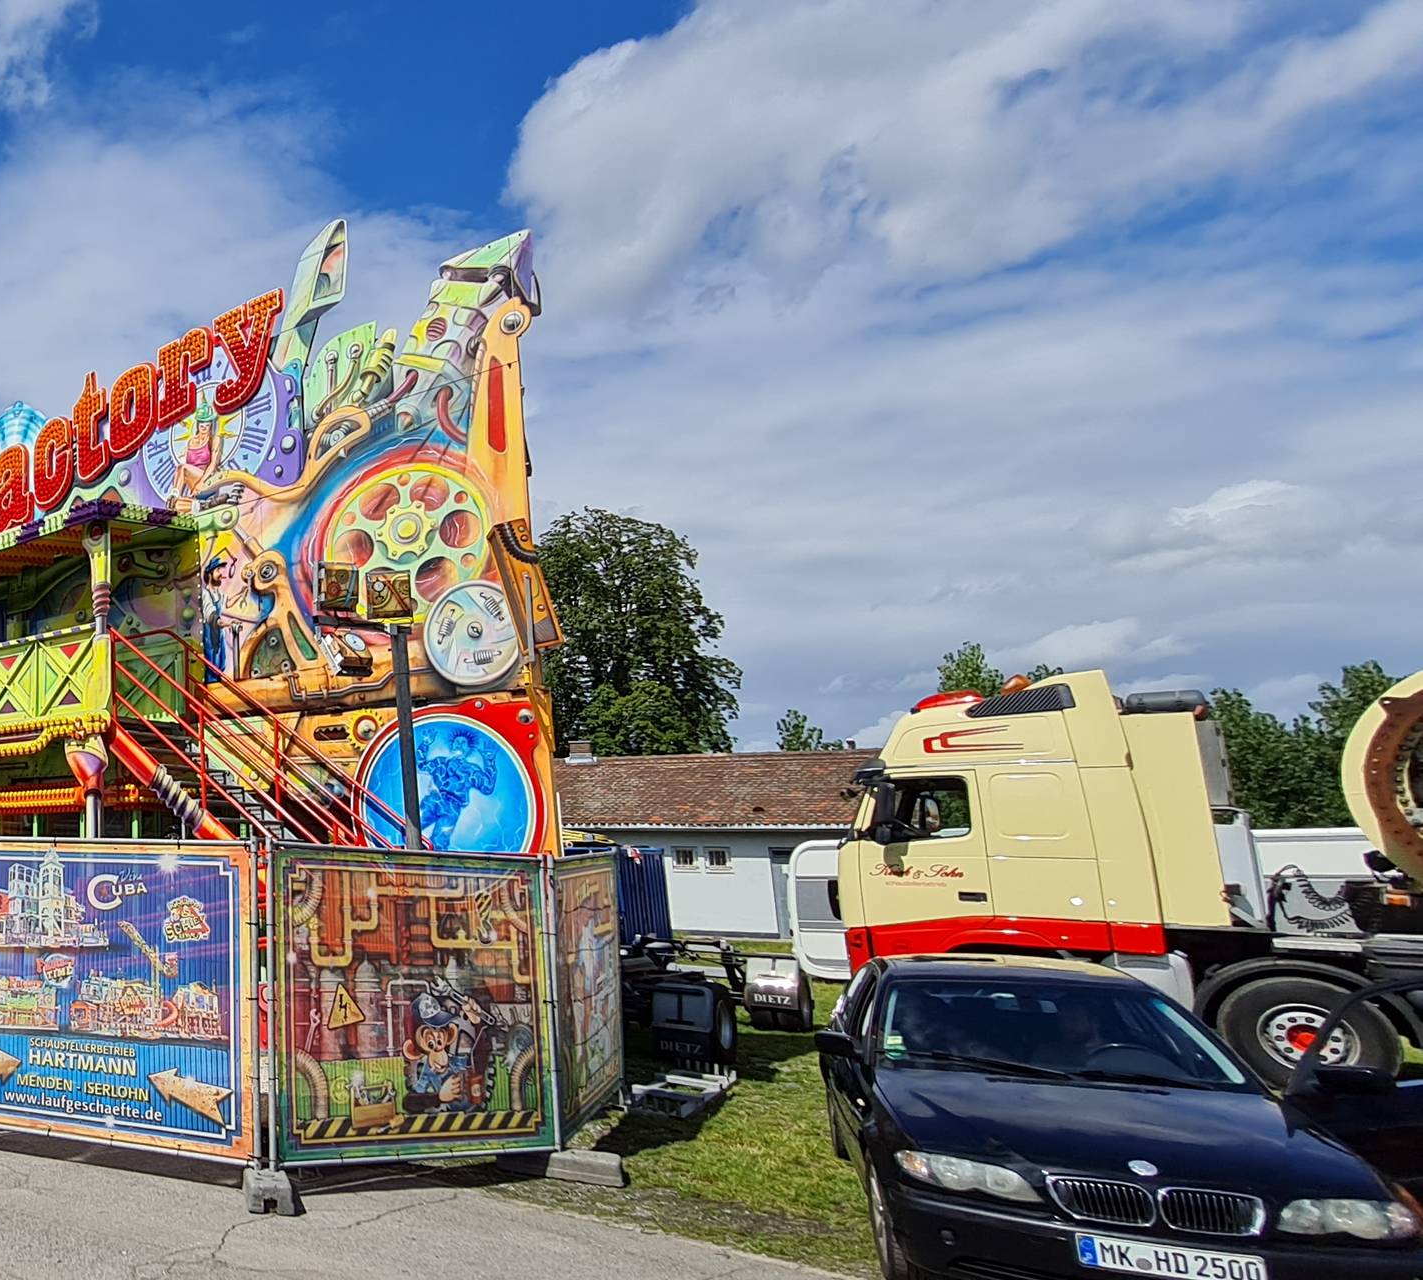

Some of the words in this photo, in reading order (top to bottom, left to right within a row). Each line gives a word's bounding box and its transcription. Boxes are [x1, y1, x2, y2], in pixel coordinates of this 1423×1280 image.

[924, 864, 964, 878] Sohn
[87, 873, 148, 910] CUBA
[753, 993, 792, 1005] DIETZ
[29, 1037, 136, 1058] SCHAUSTELLERBETRIEB
[660, 1039, 703, 1054] DIETZ
[28, 1049, 138, 1077] HARTMANN
[16, 1073, 73, 1092] MENDEN
[83, 1081, 149, 1102] ISERLOHN
[4, 1090, 163, 1122] www.laufgeschaefte.de
[1099, 1242, 1134, 1267] MK
[1154, 1250, 1199, 1275] HD
[1205, 1255, 1261, 1280] 2500
